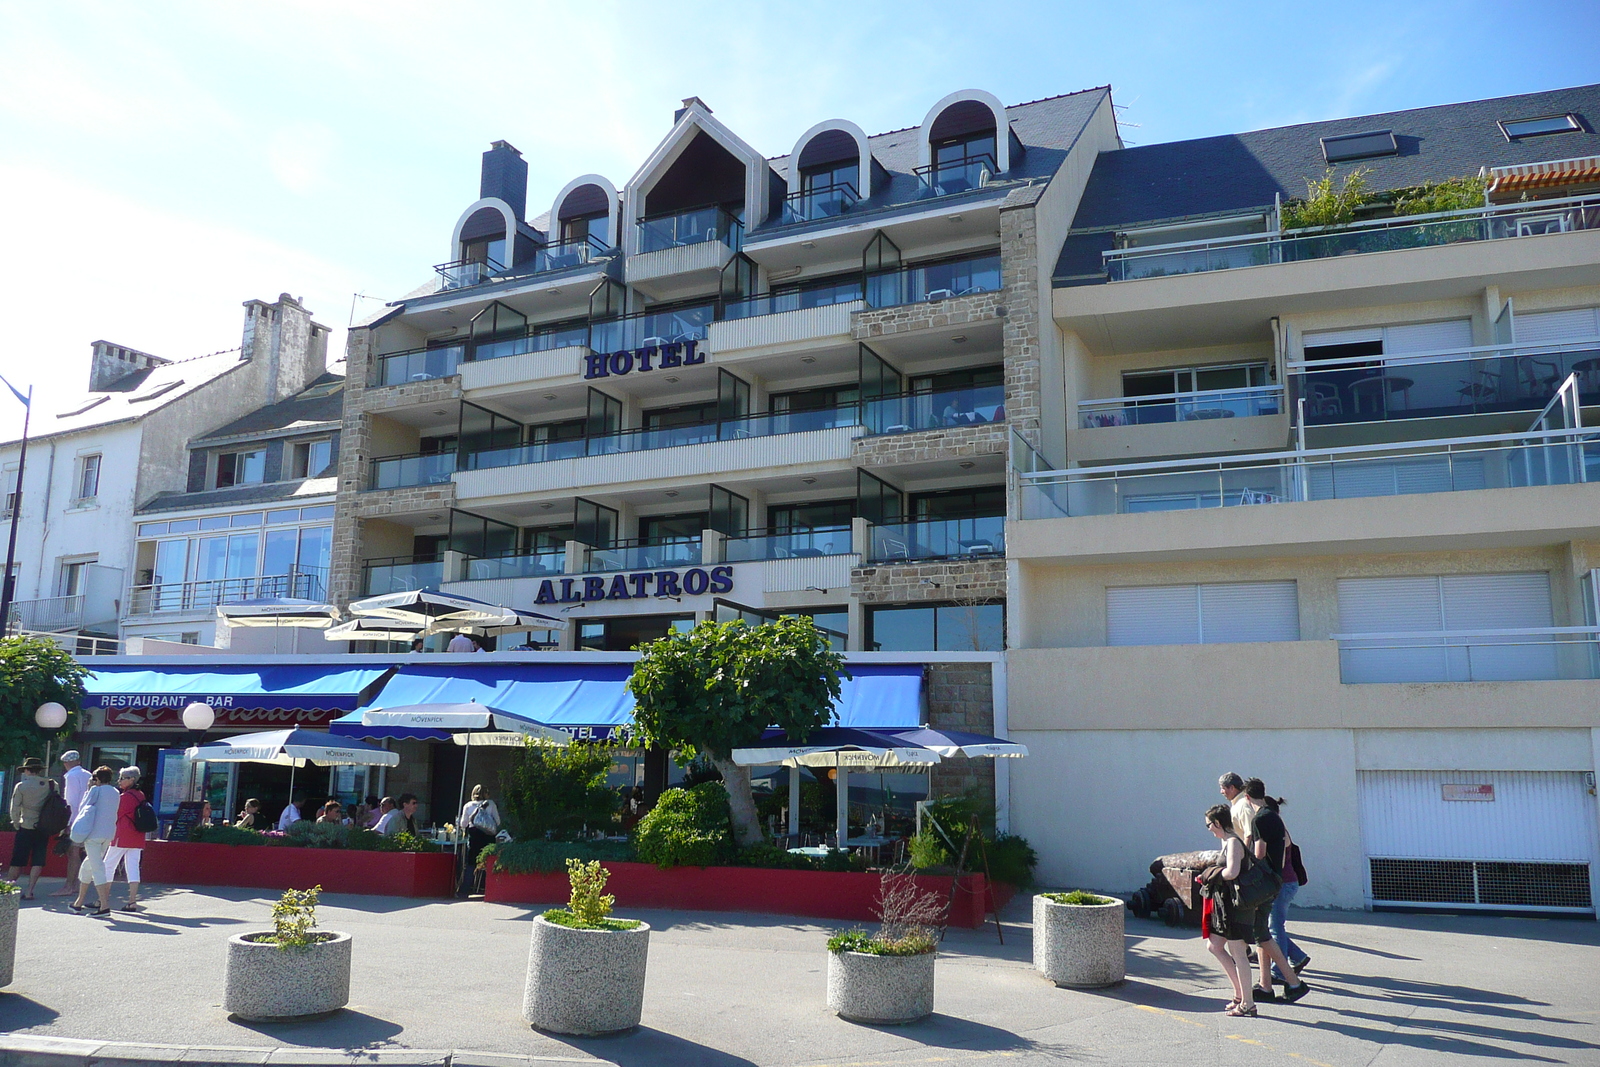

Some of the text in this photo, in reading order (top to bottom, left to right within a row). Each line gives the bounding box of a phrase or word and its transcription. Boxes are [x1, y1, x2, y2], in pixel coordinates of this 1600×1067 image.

[584, 340, 705, 379] HOTEL
[534, 566, 734, 604] ALBATROS
[101, 695, 187, 707] RESTAURANT
[205, 696, 234, 707] BAR
[411, 715, 444, 723] MÖVENPICK
